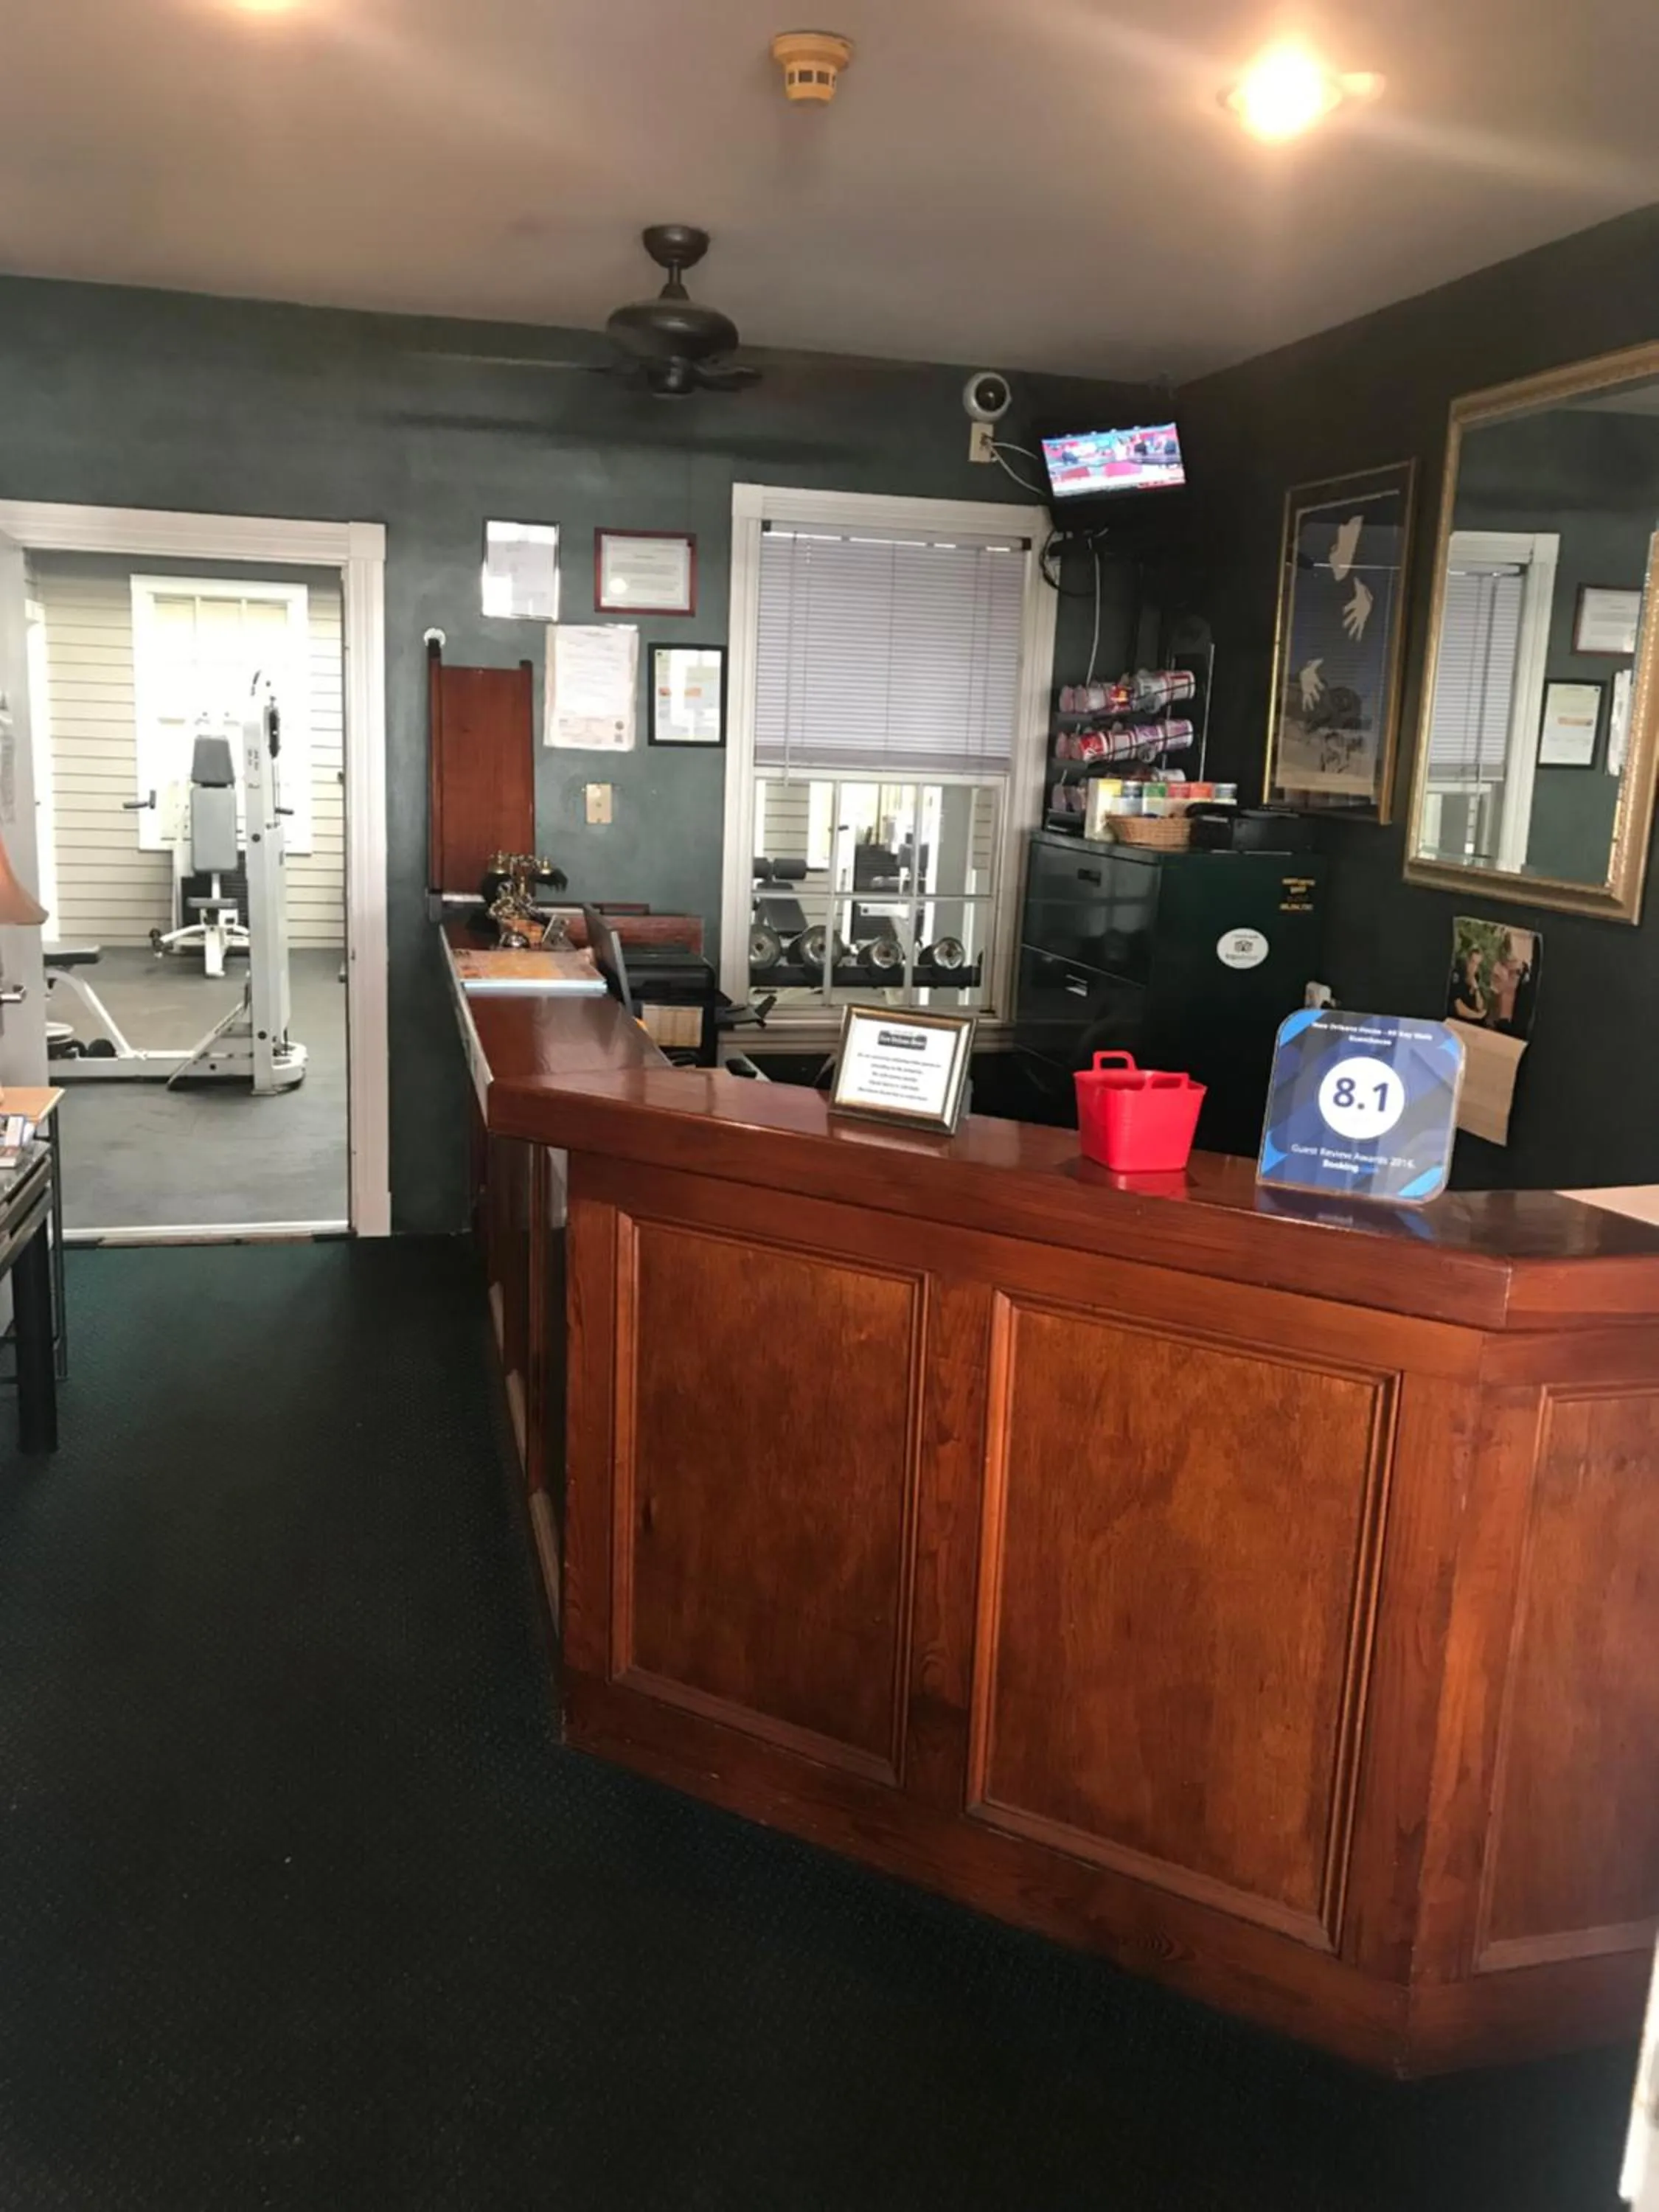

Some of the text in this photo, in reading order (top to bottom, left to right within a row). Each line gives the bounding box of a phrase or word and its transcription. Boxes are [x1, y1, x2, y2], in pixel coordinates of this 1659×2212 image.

[1332, 1077, 1389, 1112] 8.1
[1291, 1144, 1318, 1155] Guest
[1320, 1147, 1352, 1160] Review
[1353, 1152, 1388, 1165] Awards
[1322, 1158, 1380, 1175] Booking
